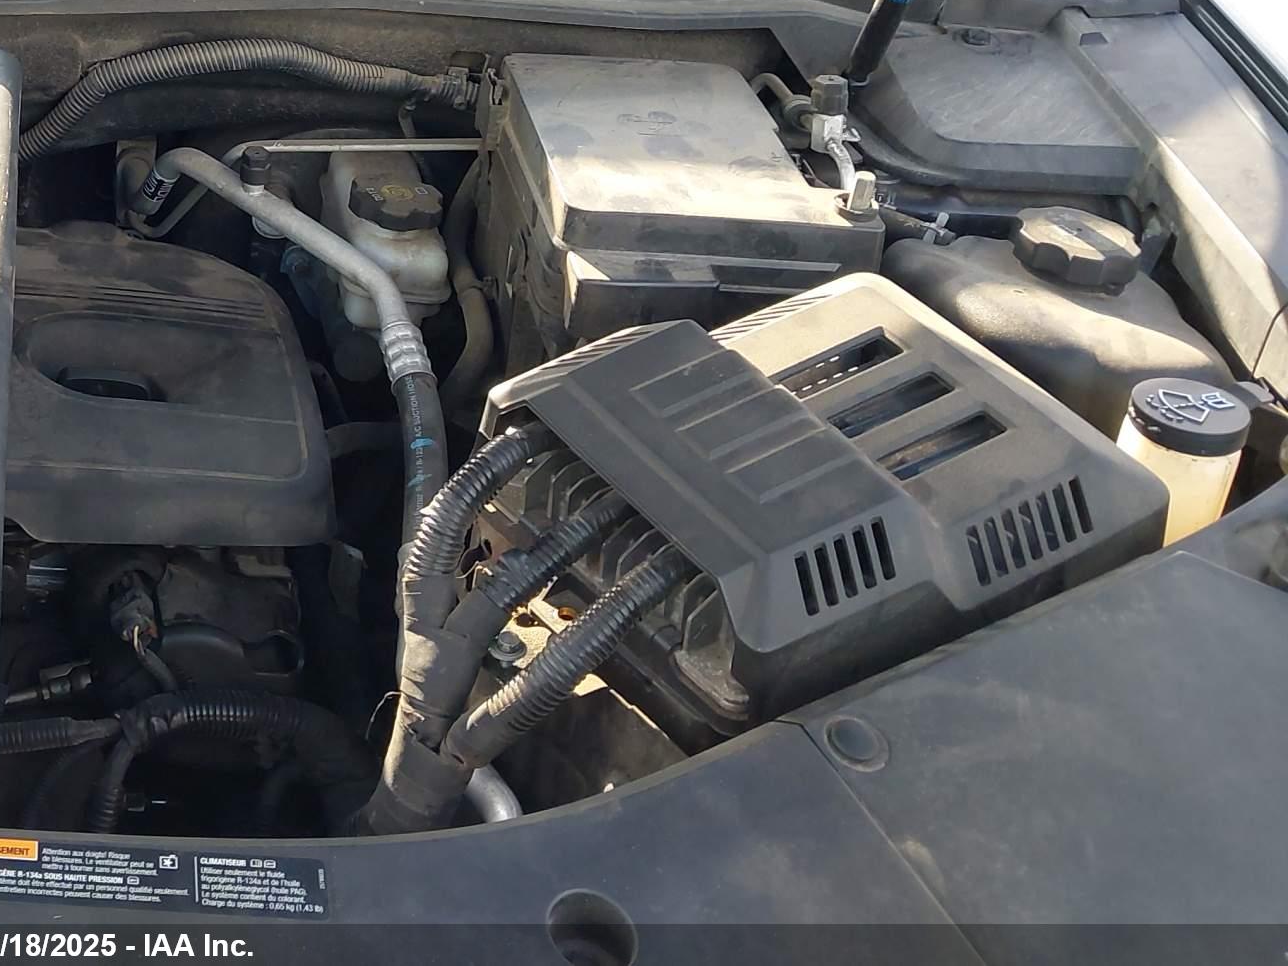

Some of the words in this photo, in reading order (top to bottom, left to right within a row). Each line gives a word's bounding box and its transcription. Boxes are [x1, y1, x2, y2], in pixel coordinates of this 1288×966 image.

[42, 848, 71, 856] Attention
[108, 852, 130, 860] Risque
[200, 857, 246, 867] CLIMATISEUR
[224, 869, 258, 877] seulement
[18, 878, 30, 886] doit
[31, 879, 44, 887] être
[43, 872, 62, 880] SOUS
[64, 873, 87, 882] HAUTE
[88, 874, 123, 884] PRESSION
[27, 888, 62, 896] incorrectes
[211, 892, 238, 900] système
[202, 898, 226, 907] Charge
[237, 901, 264, 909] système
[285, 904, 295, 912] kg
